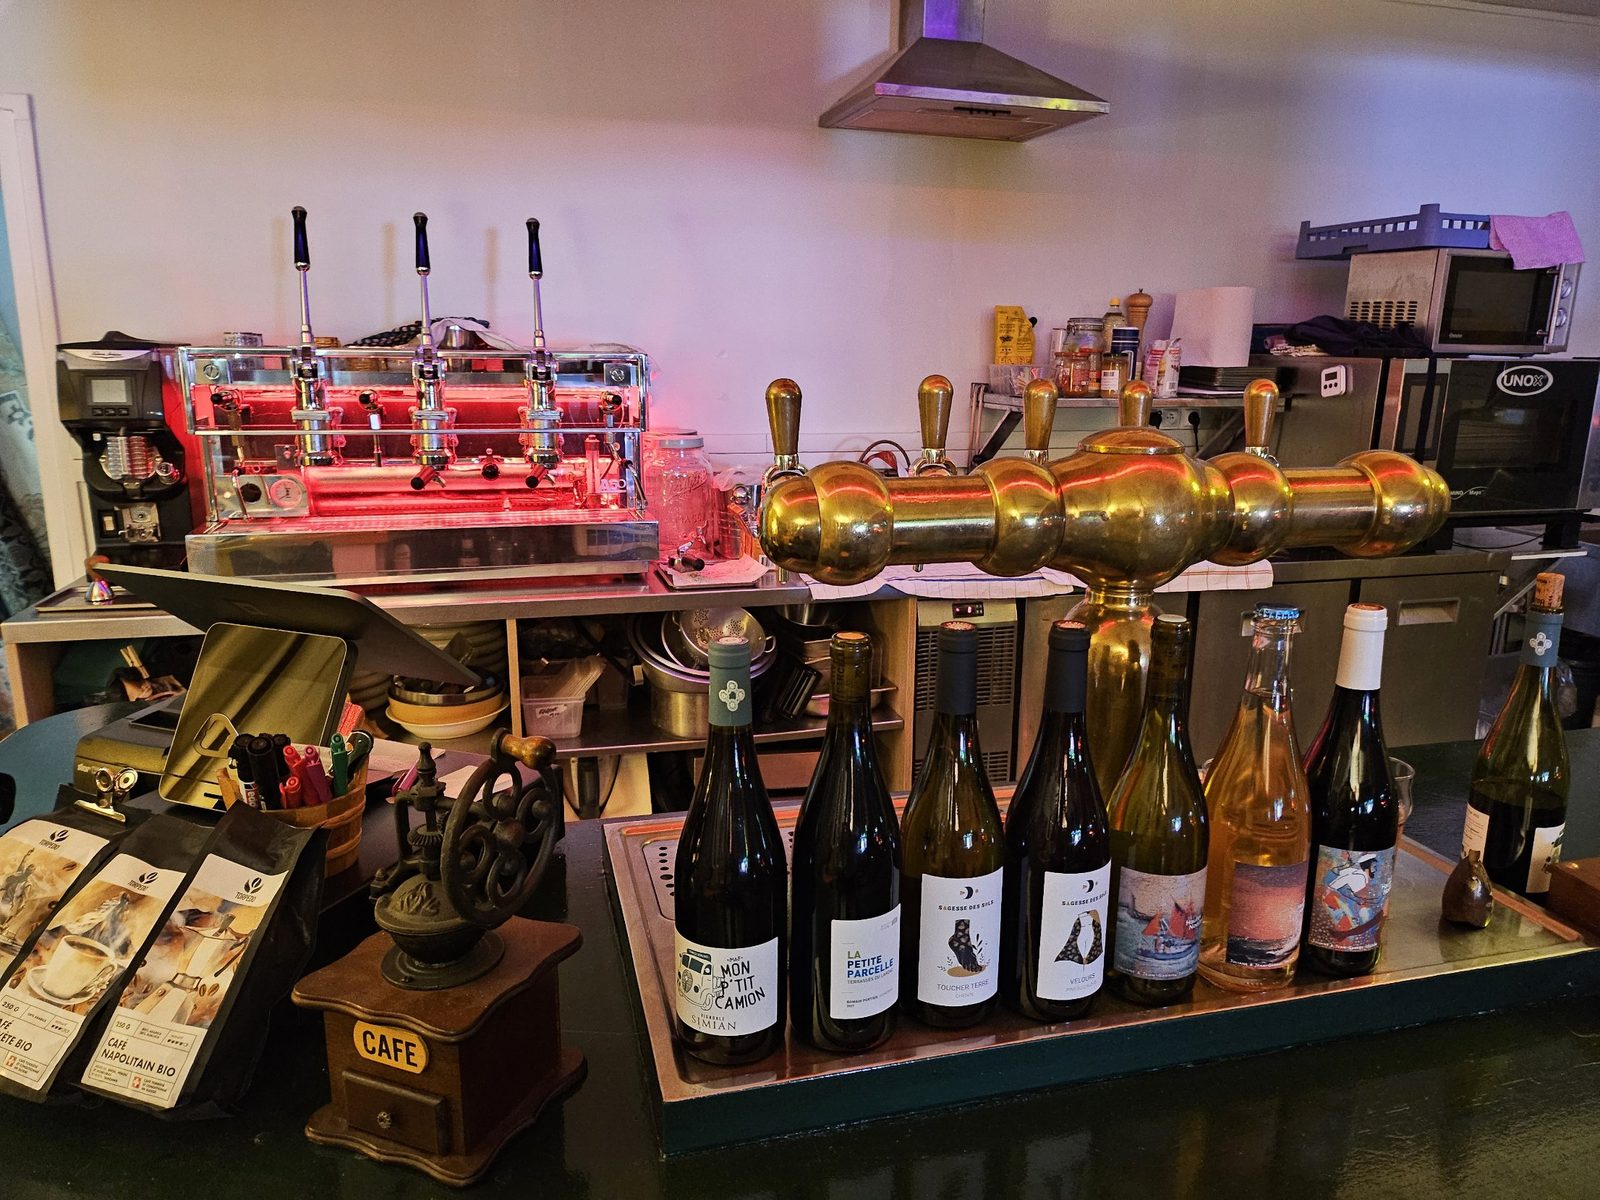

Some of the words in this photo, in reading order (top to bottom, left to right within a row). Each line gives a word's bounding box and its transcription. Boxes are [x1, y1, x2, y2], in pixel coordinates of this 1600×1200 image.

[1503, 374, 1544, 387] UNOX
[235, 891, 257, 903] TORPEDO
[847, 950, 861, 960] LA
[847, 955, 882, 969] PETITE
[847, 958, 894, 978] PARCELLE
[721, 960, 750, 978] MON
[721, 975, 755, 997] P'TIT
[937, 983, 969, 992] TOUCHER
[970, 980, 989, 989] TERRE
[715, 986, 766, 1010] CAMION
[2, 1001, 13, 1010] 250
[115, 1021, 125, 1029] 250
[691, 1014, 736, 1030] SIMIAN
[15, 1039, 32, 1051] BIO
[107, 1037, 128, 1050] CAFÉ
[362, 1030, 418, 1068] CAFE
[101, 1048, 156, 1072] NAPOLITAIN
[156, 1064, 176, 1077] BIO
